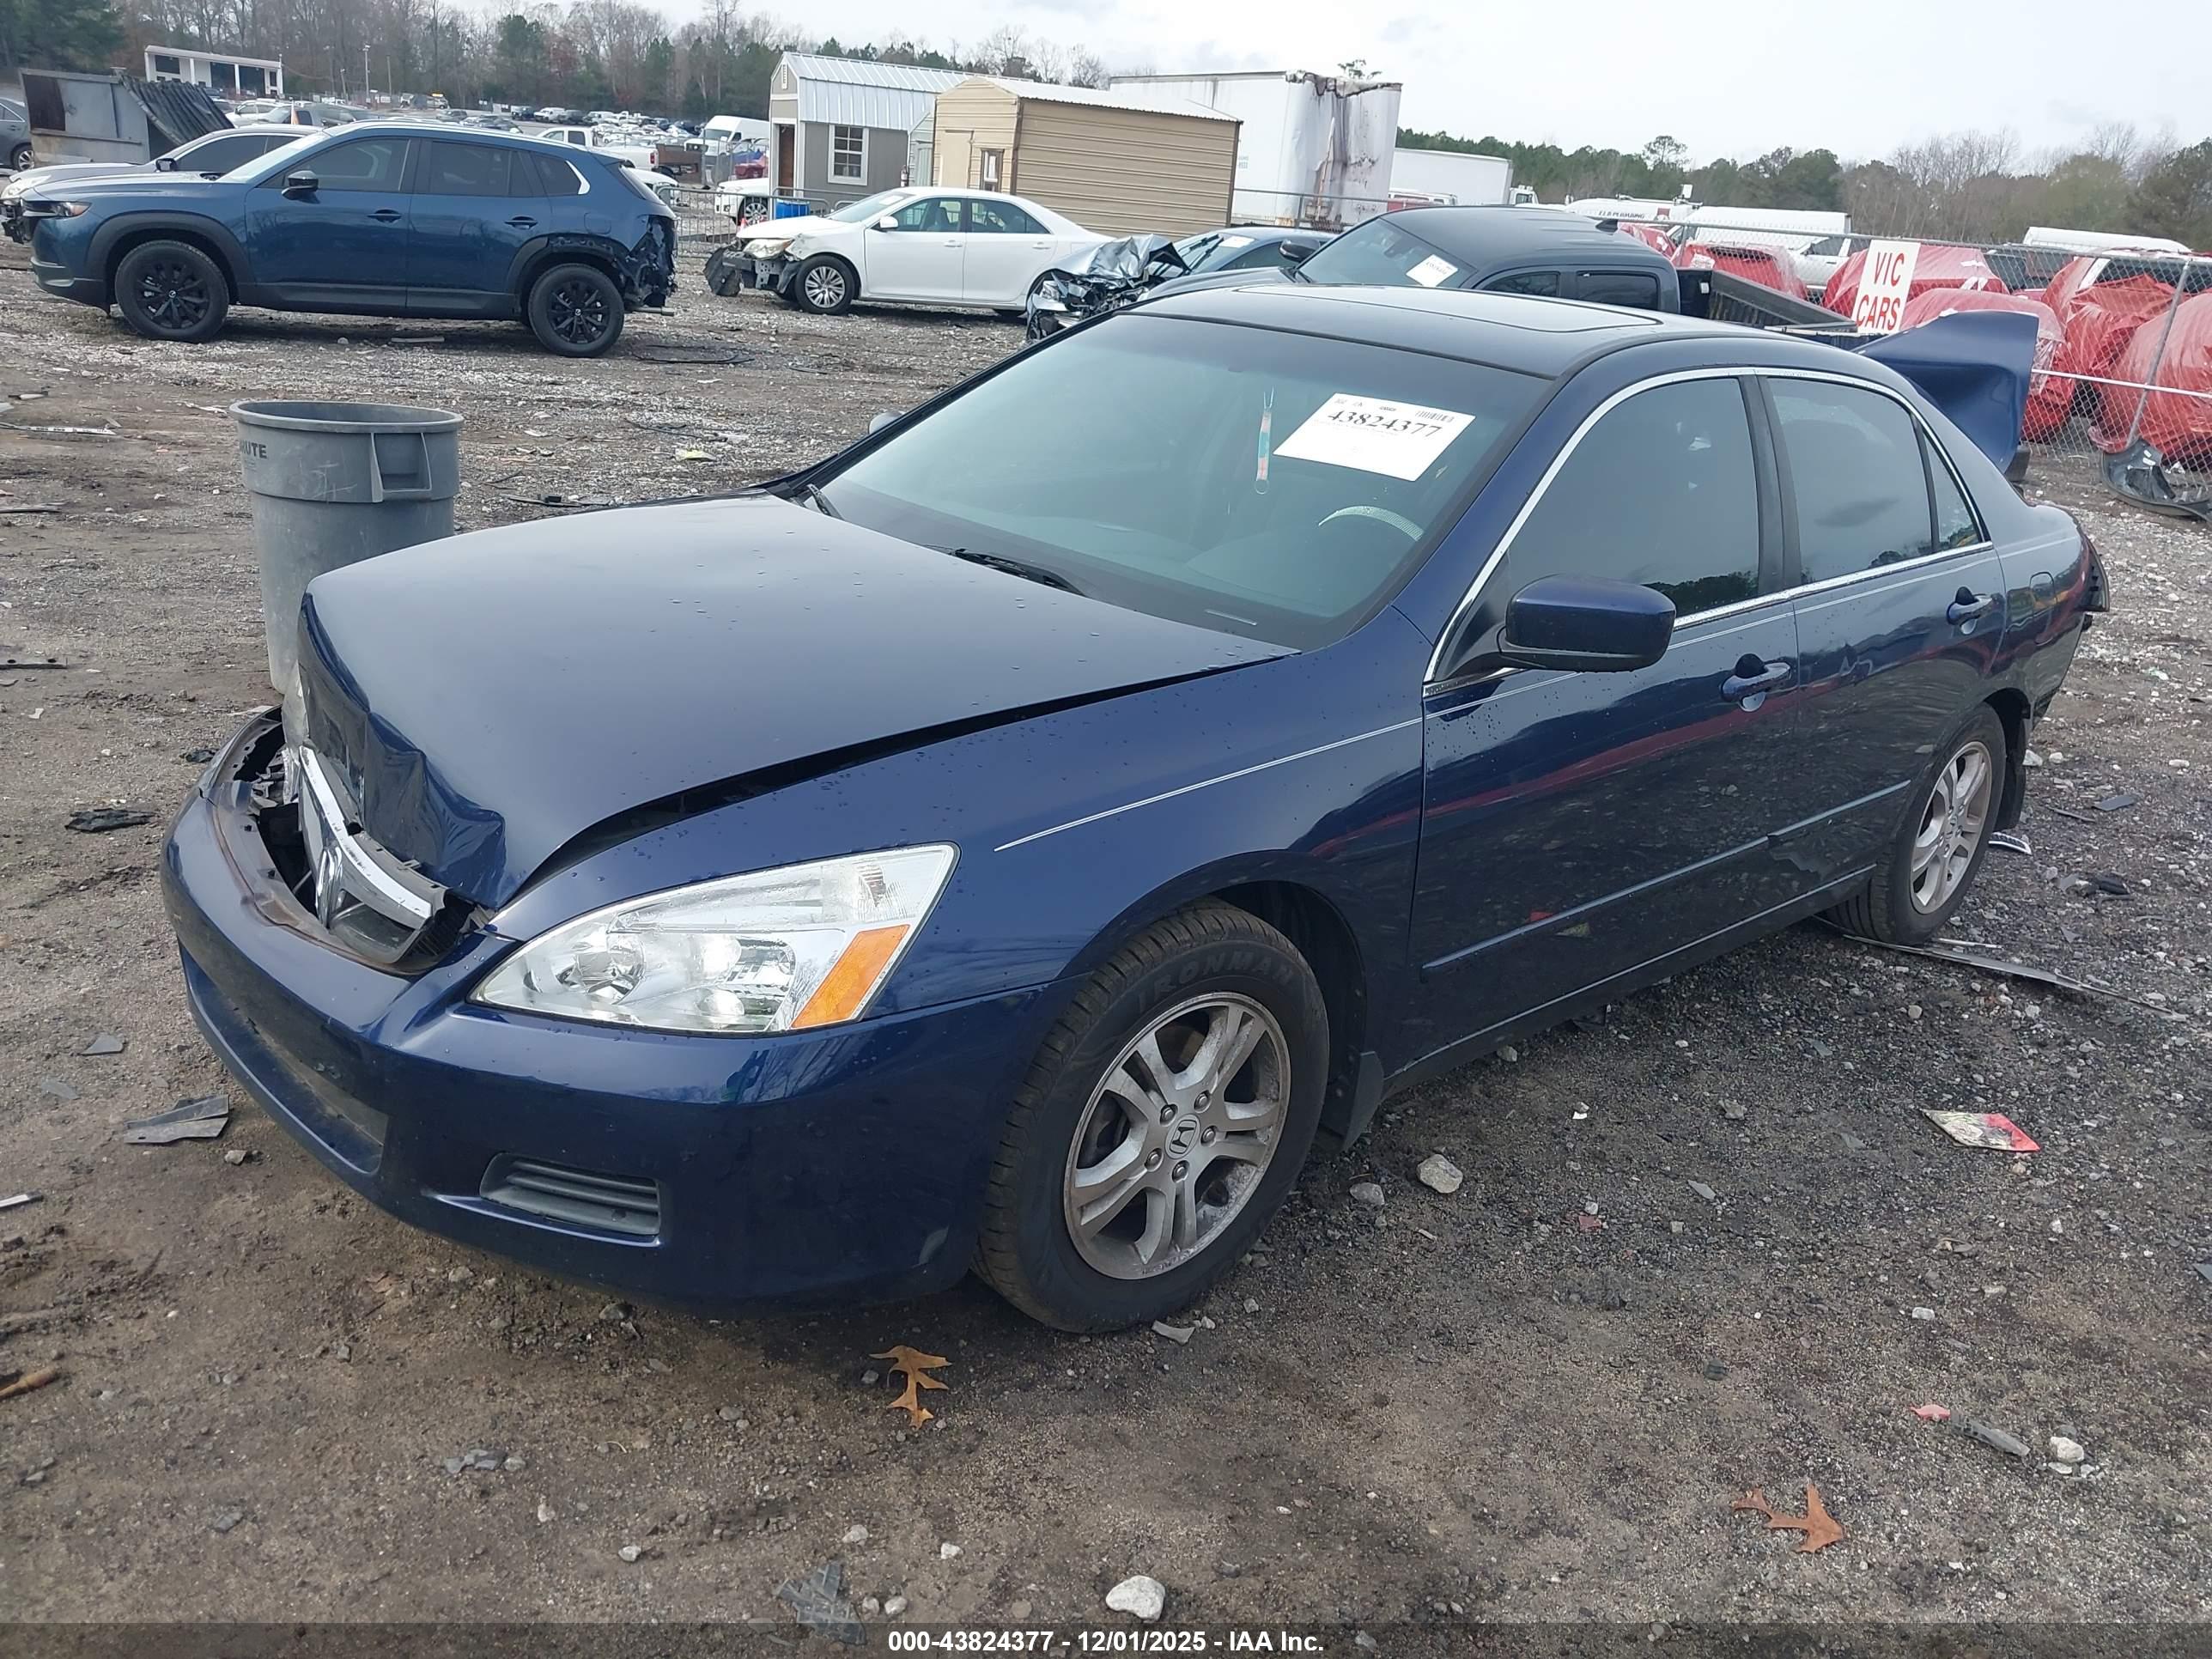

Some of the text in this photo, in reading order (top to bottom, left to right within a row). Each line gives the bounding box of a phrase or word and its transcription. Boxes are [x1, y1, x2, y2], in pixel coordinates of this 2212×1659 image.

[1873, 252, 1905, 287] VIC
[1856, 294, 1900, 331] CARS
[1328, 410, 1443, 437] 43824377
[1139, 951, 1292, 1014] IRONMAN
